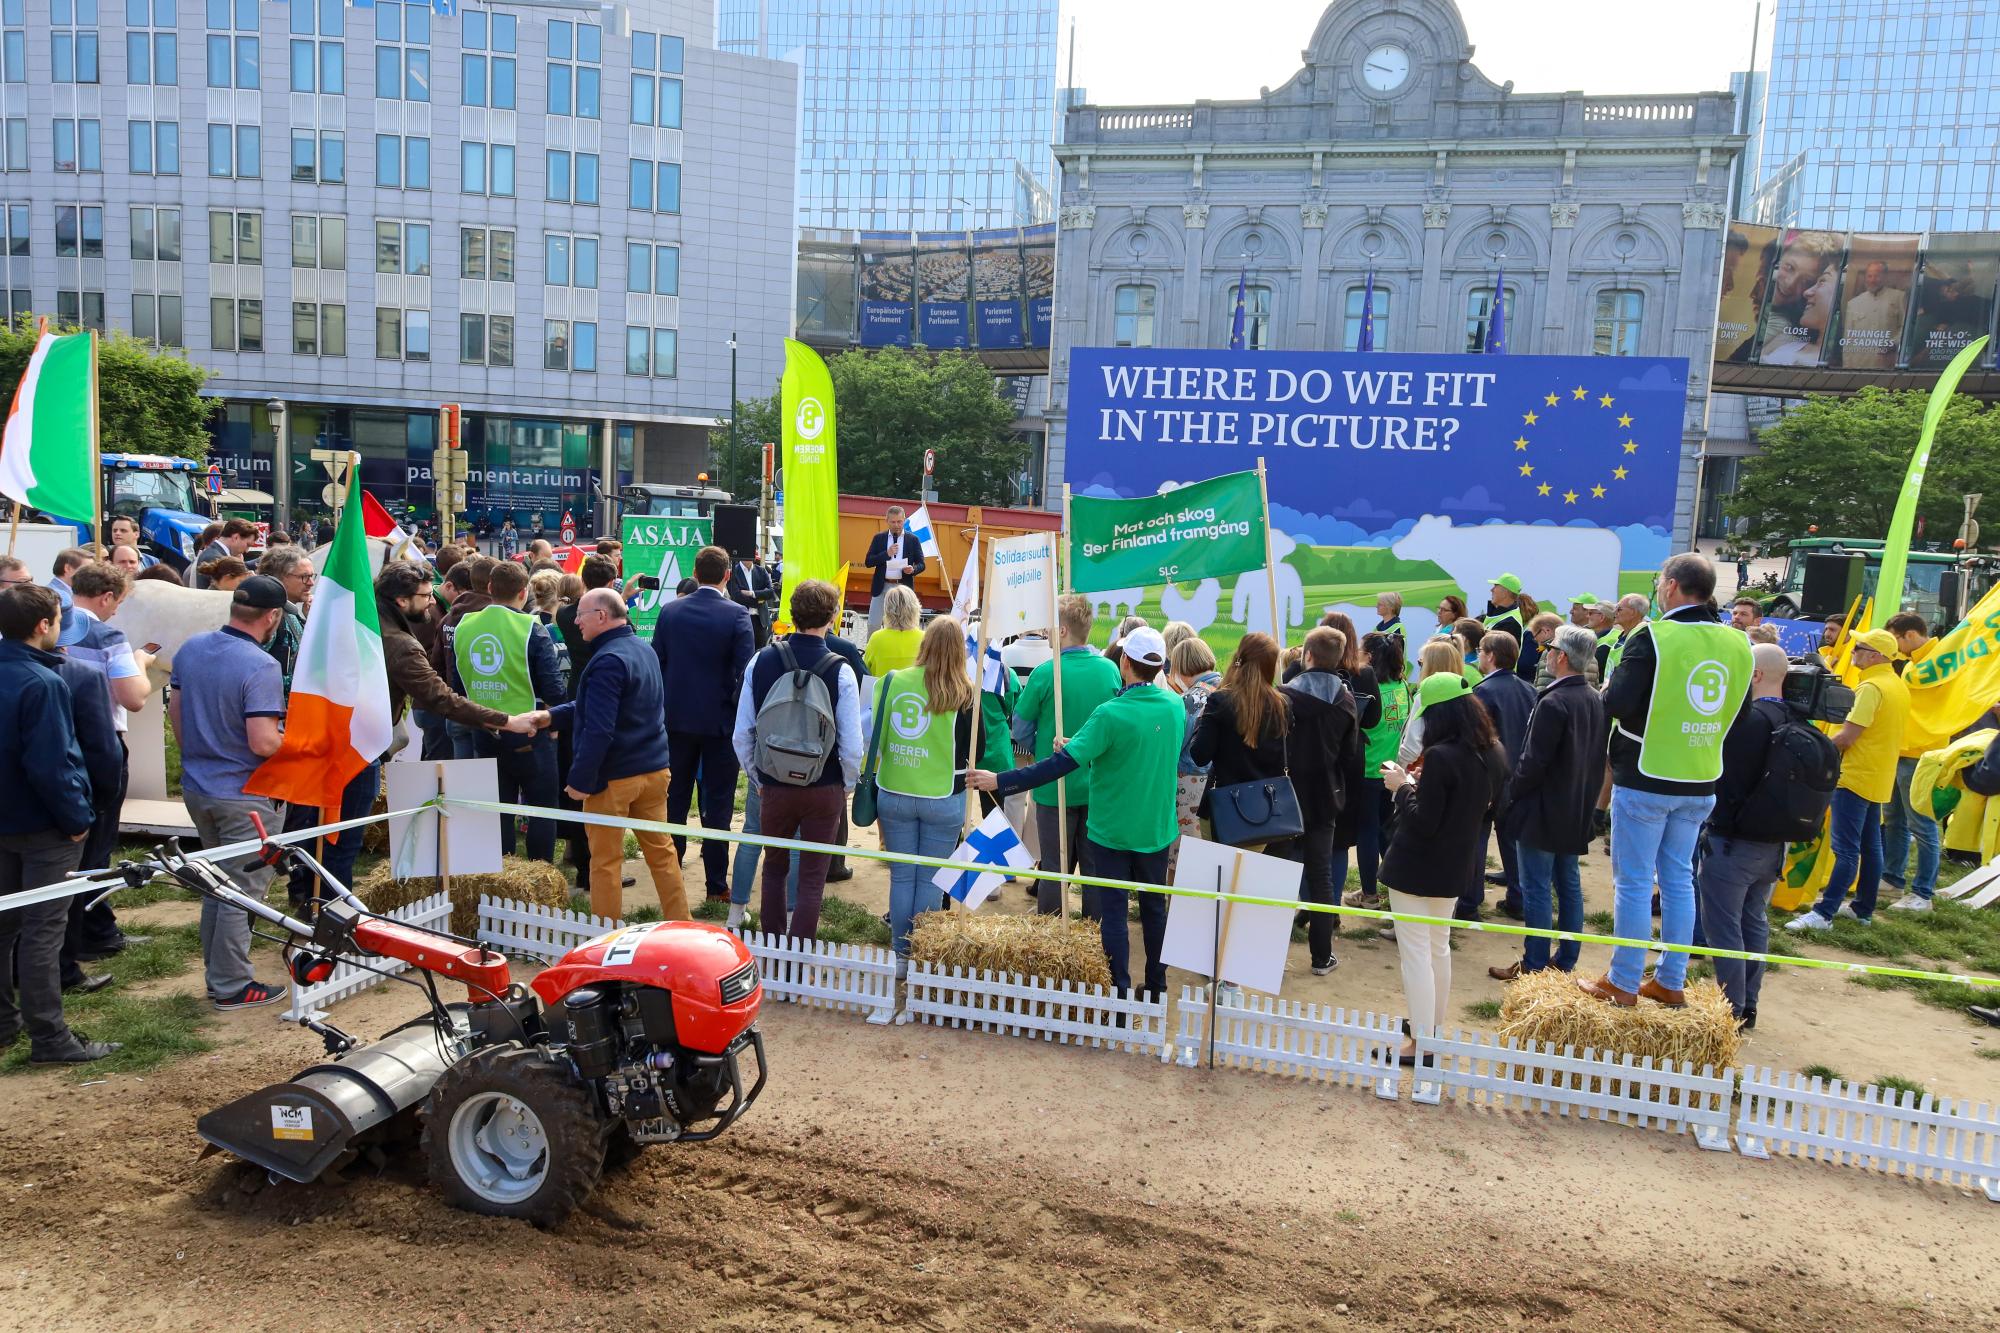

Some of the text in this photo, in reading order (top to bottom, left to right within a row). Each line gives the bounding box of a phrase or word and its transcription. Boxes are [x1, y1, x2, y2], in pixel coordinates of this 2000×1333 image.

[930, 308, 957, 317] European
[928, 317, 959, 325] Parliament
[1721, 330, 1738, 339] DAYS
[1783, 326, 1808, 336] CLOSE
[1846, 329, 1892, 339] TRIANGLE
[1839, 338, 1894, 347] OF SADNESS
[1101, 365, 1496, 407] WHERE DO WE FIT
[1099, 408, 1460, 452] IN THE PICTURE?
[1114, 507, 1215, 537] Mat och skog
[627, 525, 706, 547] ASAJA
[1083, 519, 1250, 557] ger Finland framgång
[1158, 565, 1179, 577] SLC
[471, 681, 508, 691] BOEREN
[476, 691, 502, 701] BOND
[1681, 721, 1721, 734] BOEREN
[889, 743, 929, 758] BOEREN
[893, 754, 921, 768] BOND
[280, 1108, 303, 1120] NCM
